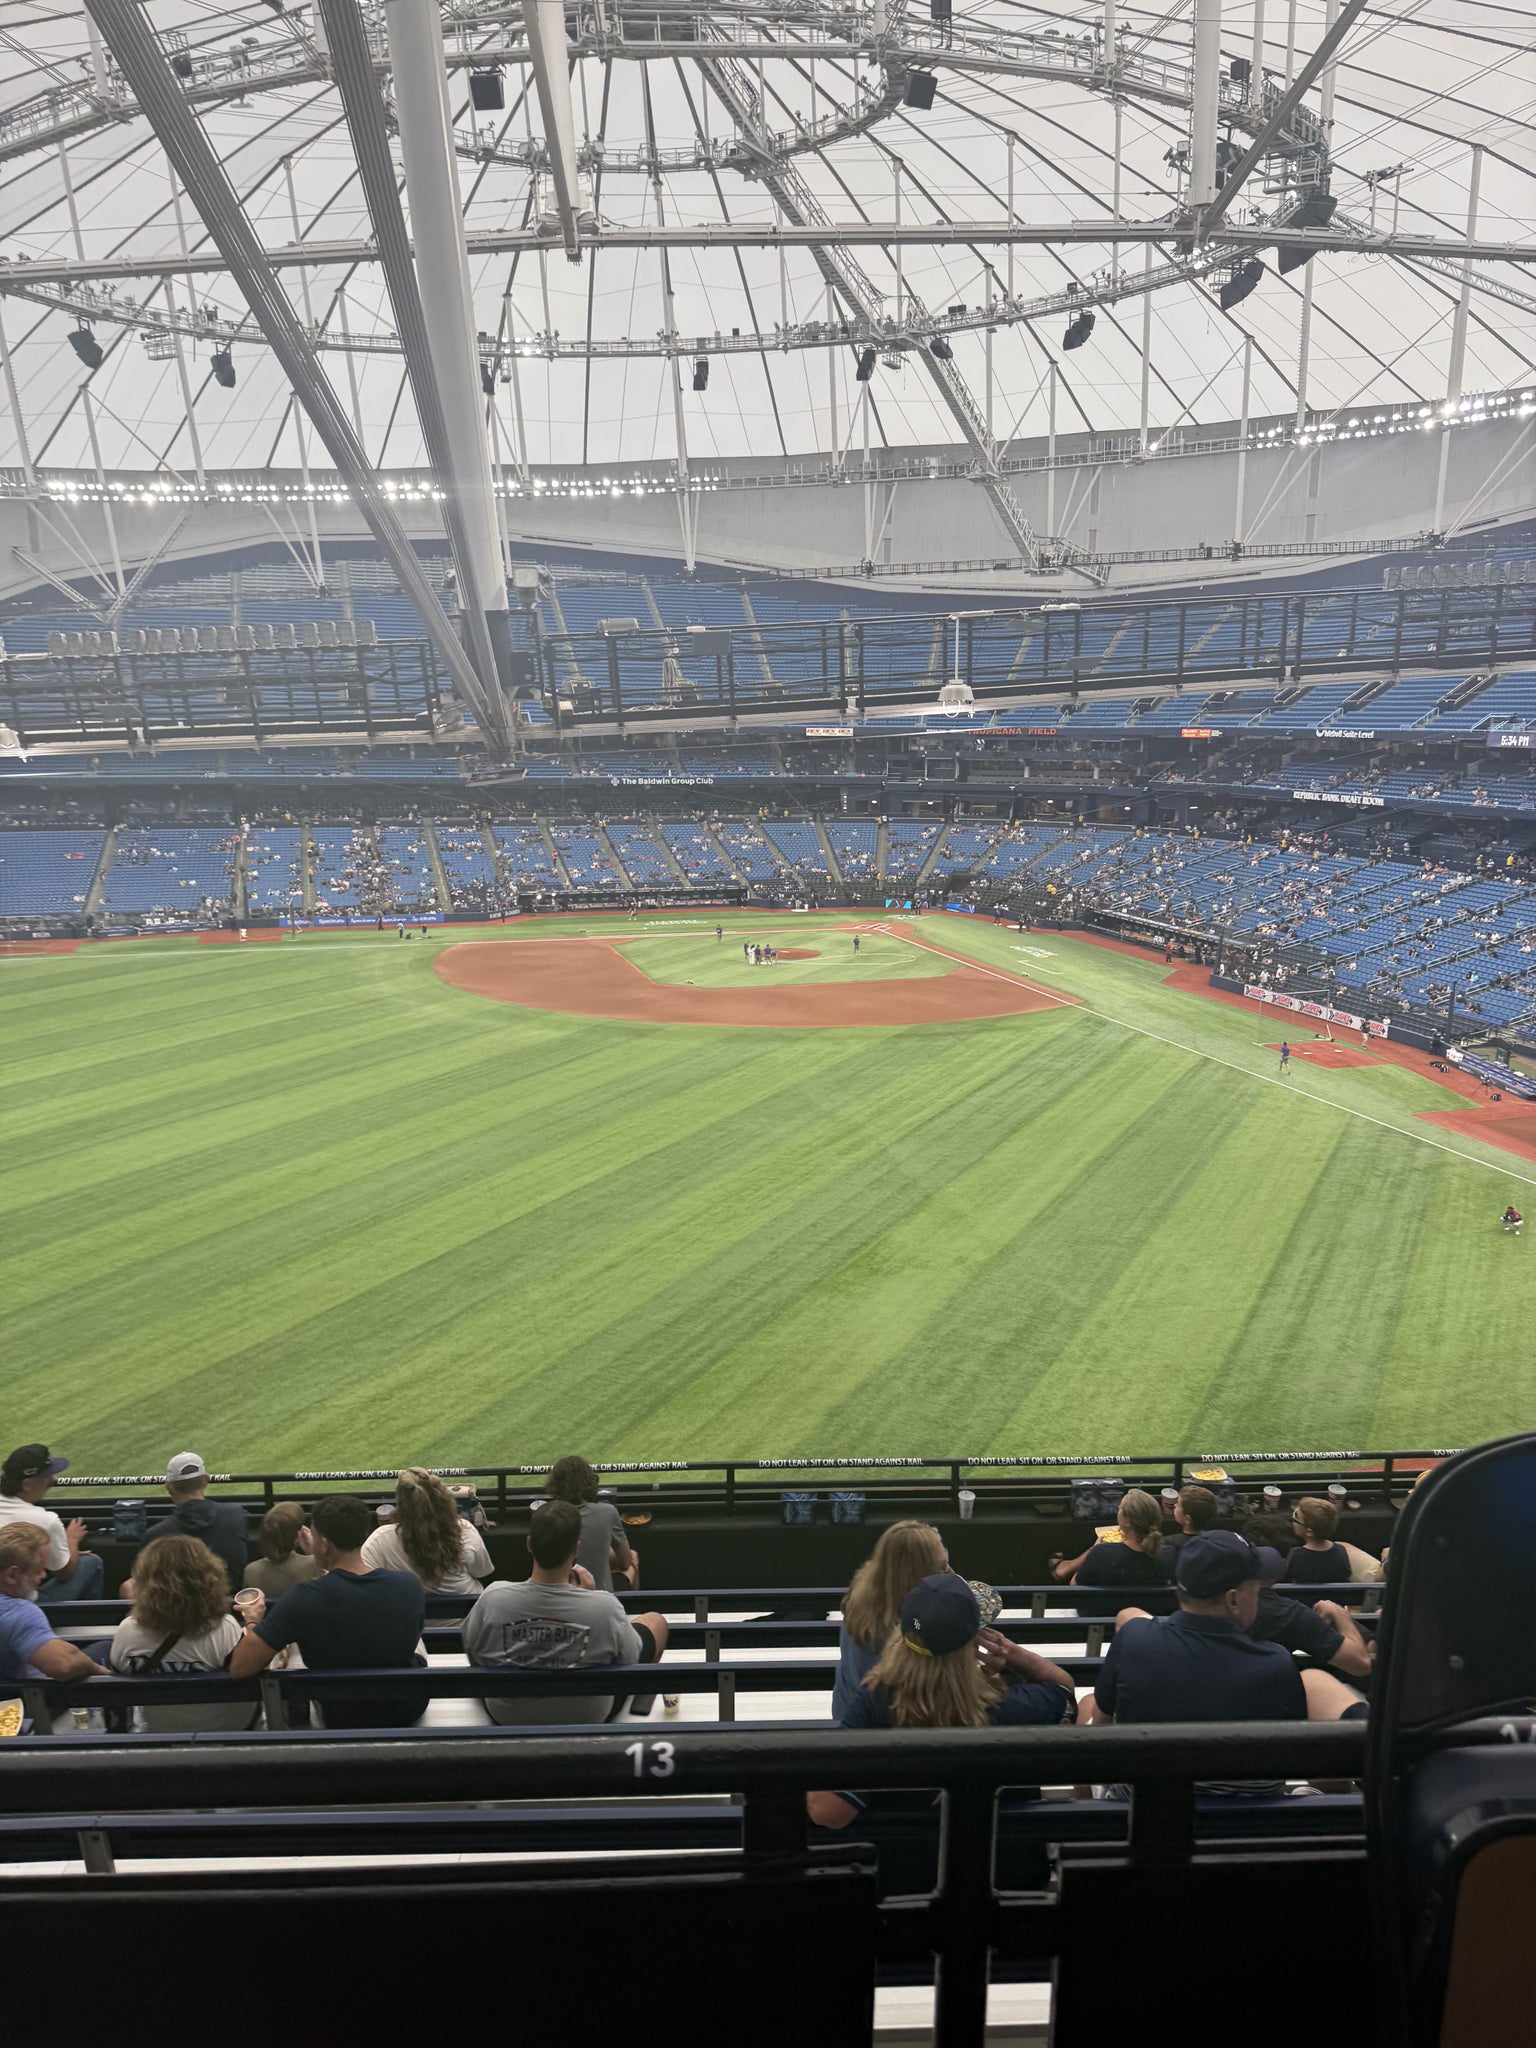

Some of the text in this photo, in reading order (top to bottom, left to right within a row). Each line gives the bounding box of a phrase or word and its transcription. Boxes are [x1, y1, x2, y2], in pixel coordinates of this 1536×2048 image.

[1501, 735, 1530, 747] 5:34 PM
[671, 778, 695, 786] Group
[696, 777, 714, 785] Club
[1322, 793, 1340, 802] BANK
[1362, 796, 1384, 806] ROOM
[838, 1458, 848, 1466] OR
[849, 1458, 873, 1466] STAND
[968, 1457, 980, 1465] DO
[980, 1457, 996, 1465] NOT
[1057, 1456, 1082, 1464] STAND
[1083, 1456, 1114, 1464] AGAINST
[1201, 1454, 1214, 1462] DO
[1215, 1454, 1231, 1462] NOT
[1253, 1453, 1264, 1461] SIT
[1290, 1452, 1315, 1460] STAND
[1315, 1451, 1347, 1460] AGAINST
[520, 1465, 533, 1473] DO
[638, 1462, 671, 1470] AGAINST
[672, 1461, 689, 1469] RAIL
[57, 1477, 71, 1485] DO
[71, 1477, 88, 1485] NOT
[112, 1475, 125, 1484] SIT
[141, 1475, 152, 1483] OR
[153, 1475, 167, 1483] STA
[512, 1626, 579, 1641] MASTER BAIT
[625, 1742, 675, 1778] 13
